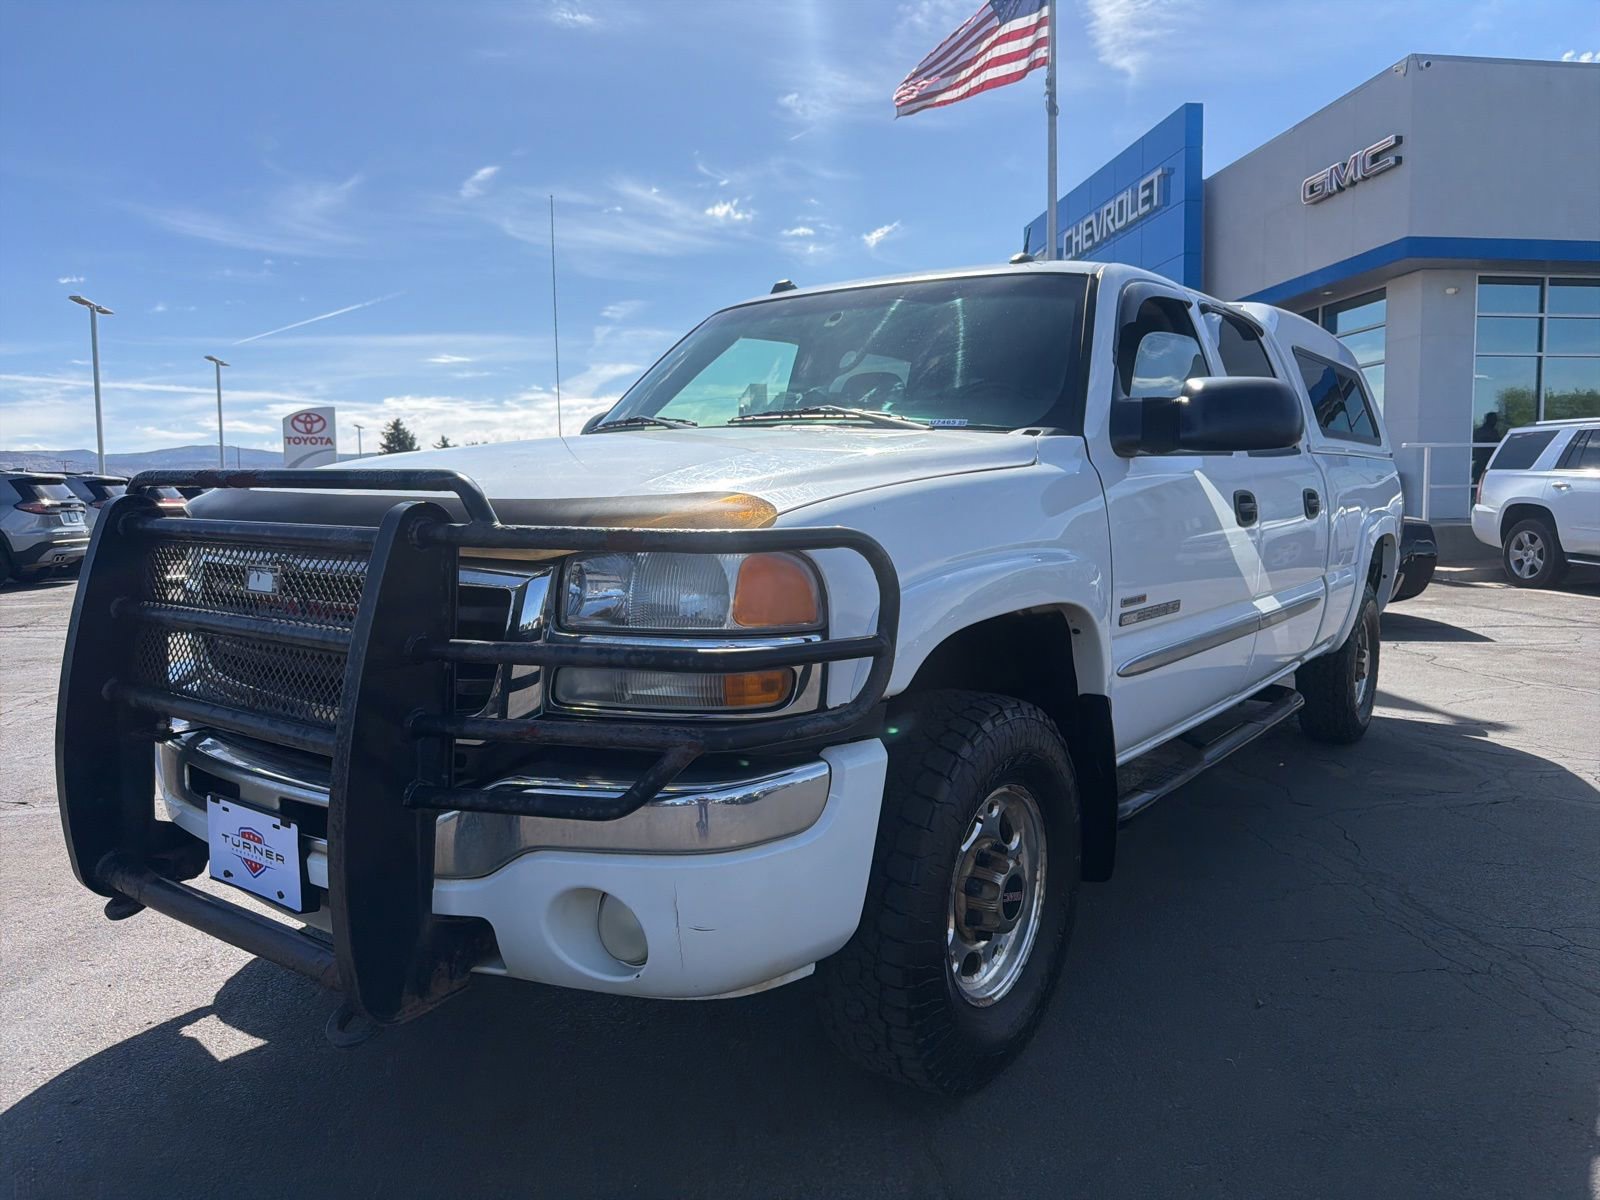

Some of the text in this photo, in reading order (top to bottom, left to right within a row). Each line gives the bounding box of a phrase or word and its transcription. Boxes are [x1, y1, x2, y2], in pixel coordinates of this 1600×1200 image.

[1301, 134, 1403, 205] GMC
[1062, 167, 1169, 260] CHEVROLET
[285, 436, 333, 446] TOYOTA
[221, 833, 285, 864] TURNER
